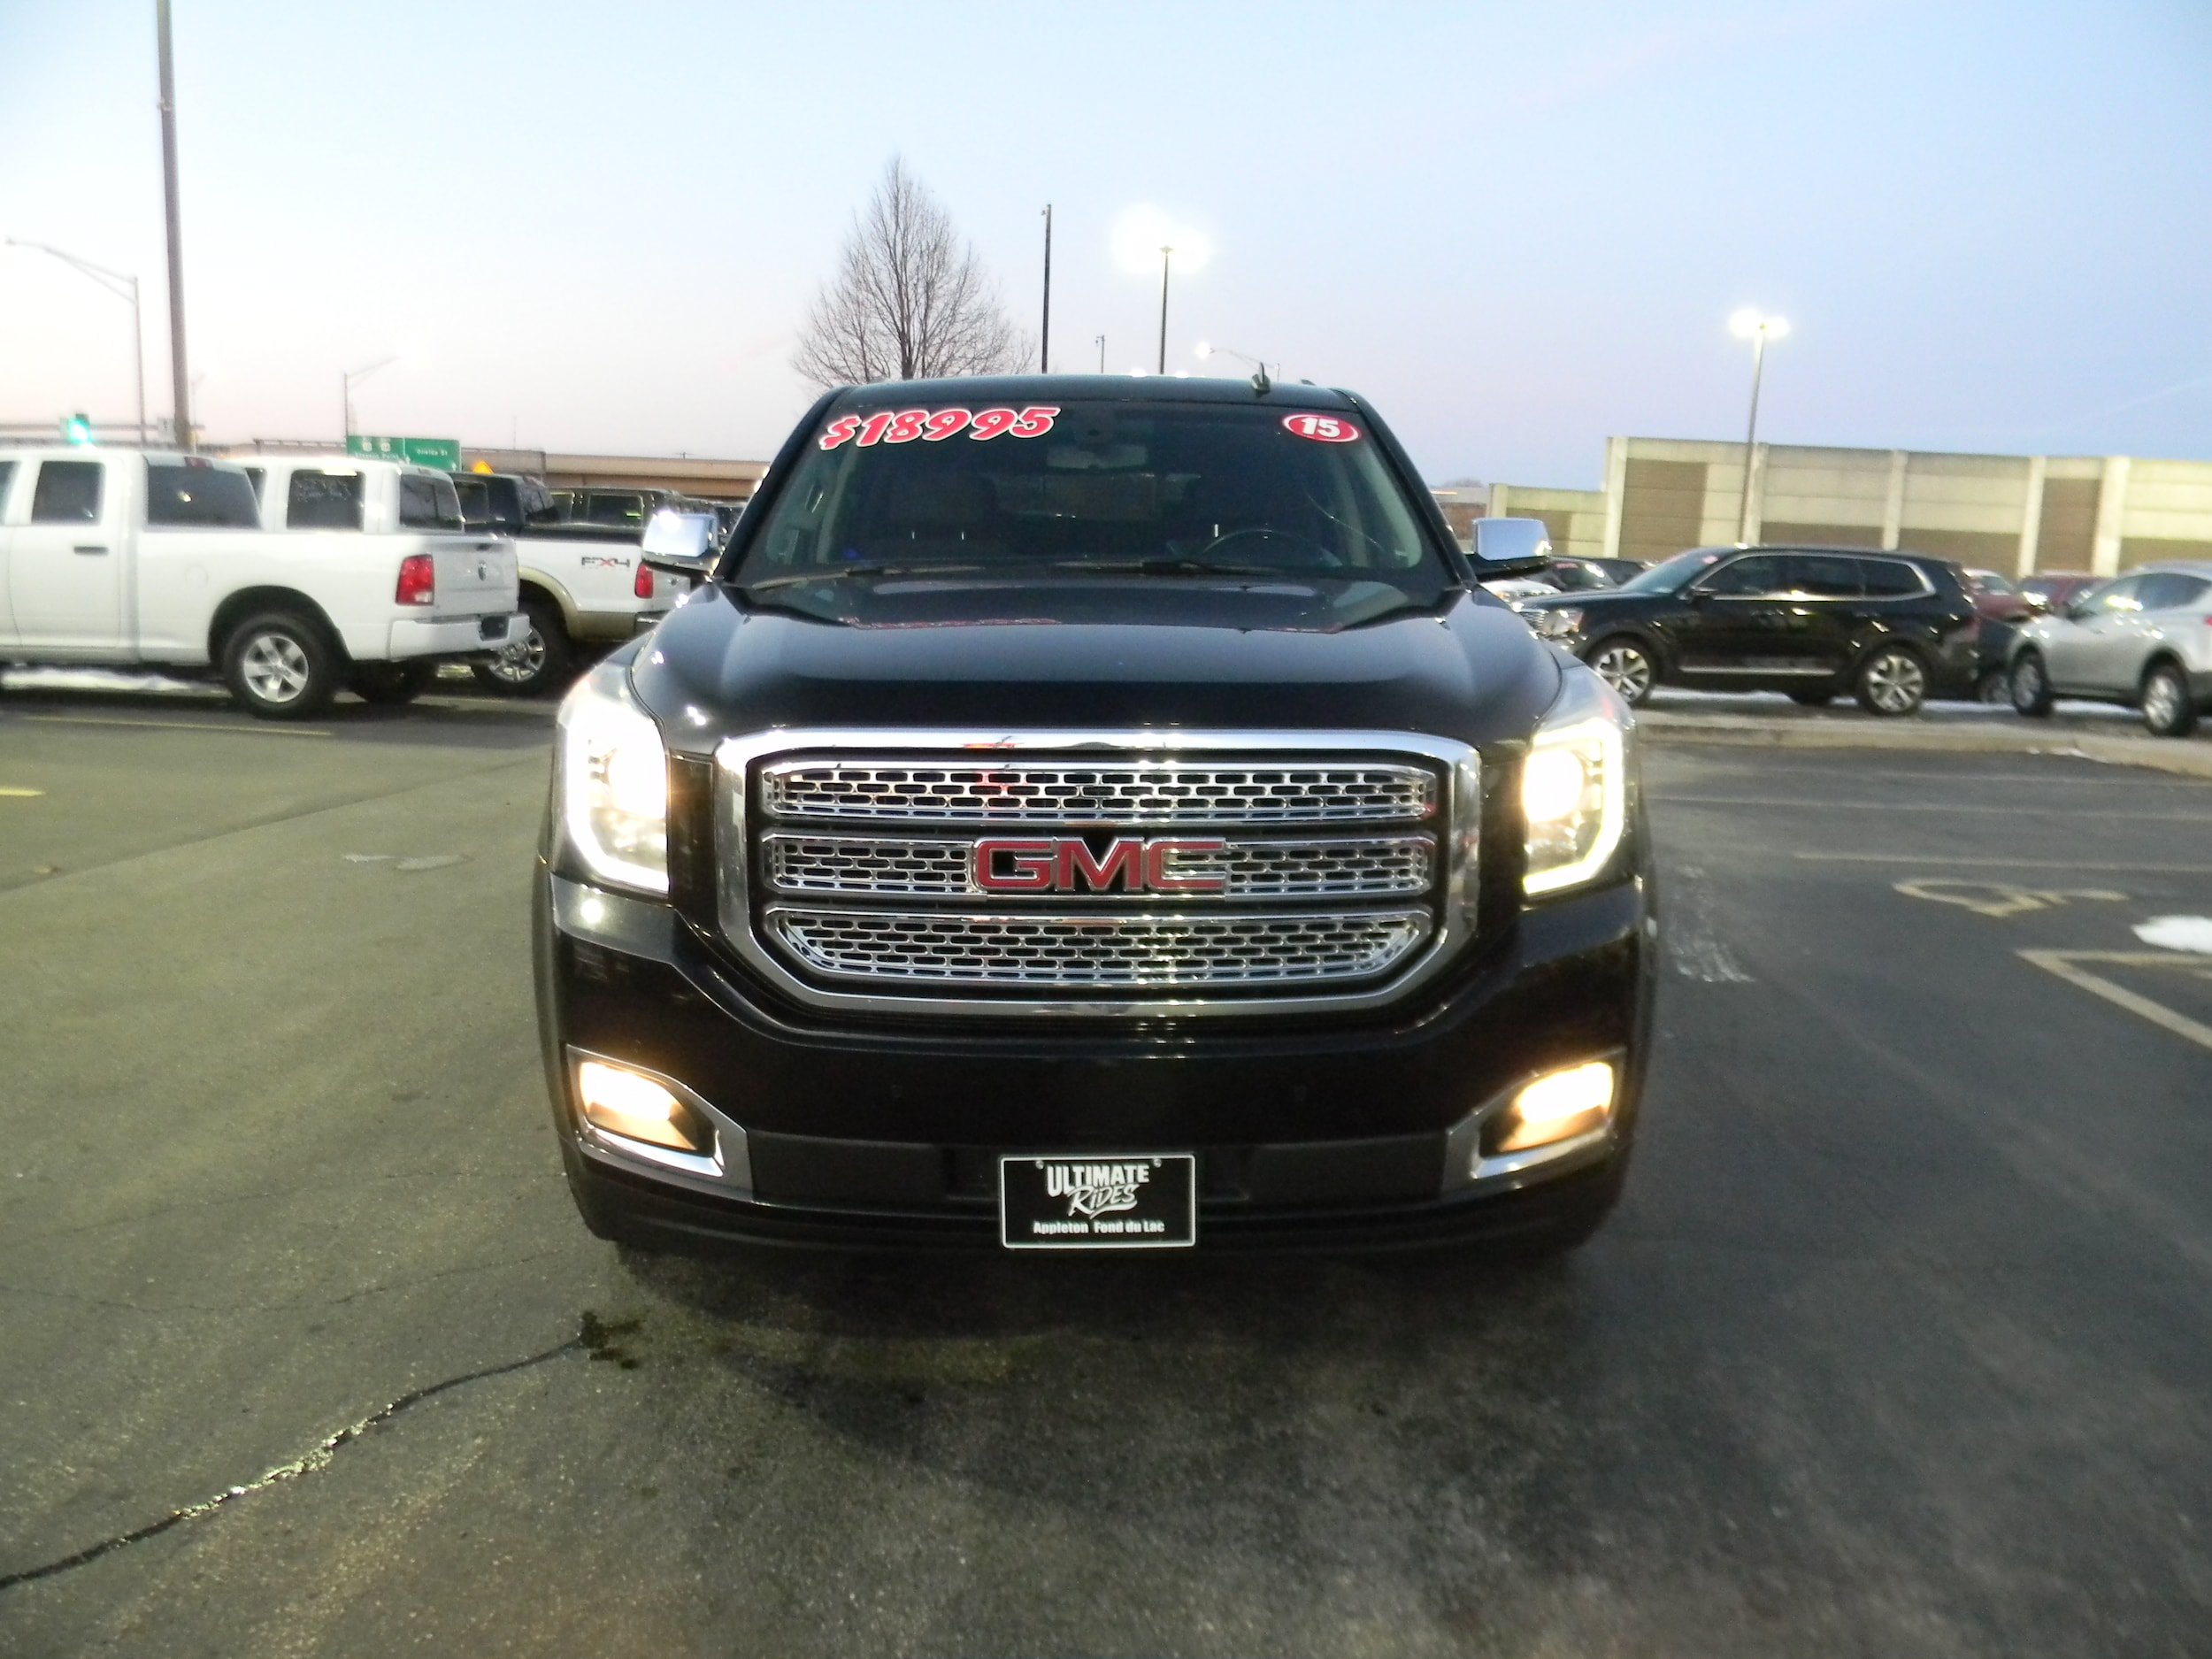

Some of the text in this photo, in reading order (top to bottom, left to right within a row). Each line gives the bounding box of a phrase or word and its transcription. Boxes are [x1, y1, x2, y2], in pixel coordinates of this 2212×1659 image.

[819, 407, 1060, 450] $18995
[1301, 417, 1340, 438] 15
[581, 557, 630, 567] FX4
[974, 836, 1226, 891] GMC
[1046, 1163, 1149, 1198] ULTIMATE
[1033, 1220, 1165, 1234] Appleton Fond du Lac
